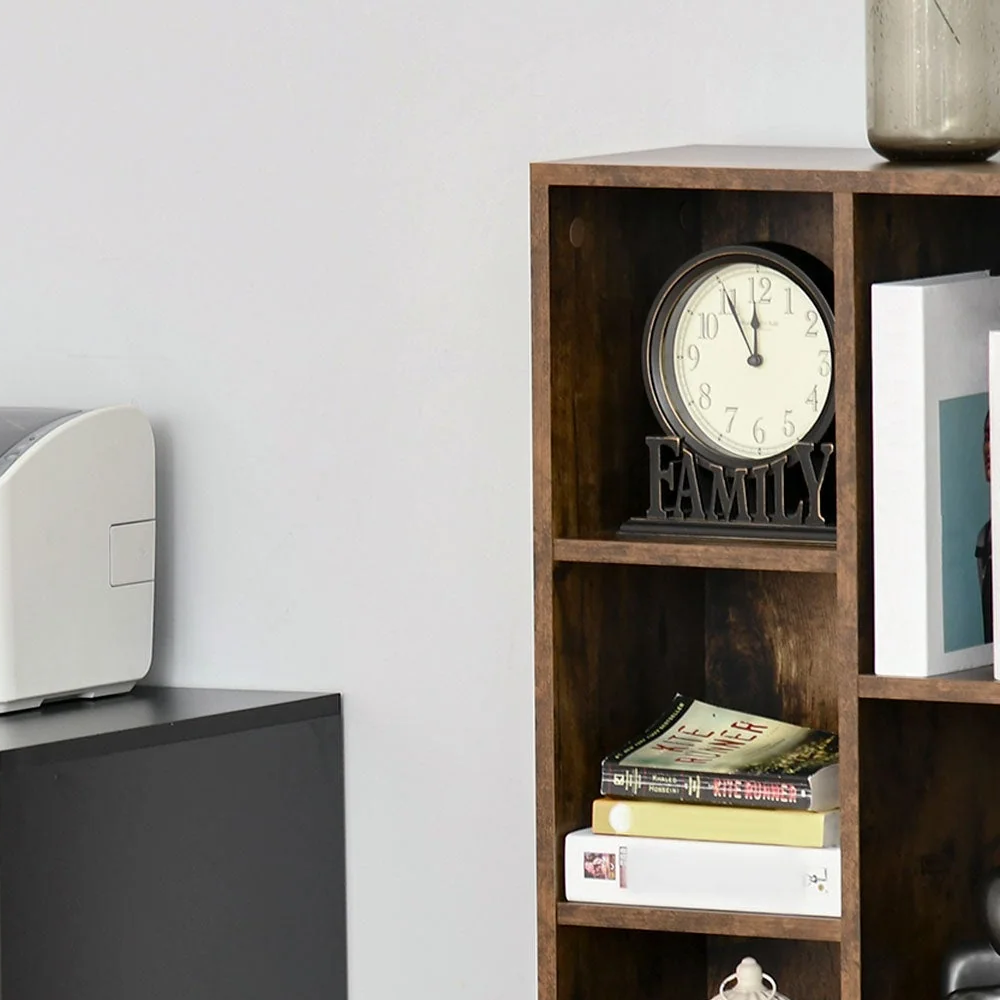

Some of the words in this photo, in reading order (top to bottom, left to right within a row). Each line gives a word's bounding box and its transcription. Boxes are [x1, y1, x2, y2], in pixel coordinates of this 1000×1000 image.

[718, 288, 740, 316] 11
[748, 276, 772, 304] 12
[784, 287, 794, 315] 1
[697, 311, 719, 340] 10
[805, 310, 819, 338] 2
[687, 344, 700, 372] 9
[818, 349, 831, 378] 3
[699, 382, 712, 410] 8
[805, 384, 819, 413] 4
[725, 406, 739, 434] 7
[753, 416, 766, 445] 6
[784, 409, 796, 438] 5
[645, 436, 834, 525] FAMILY
[651, 725, 715, 753] KITE
[675, 720, 768, 764] RUNNER
[713, 778, 742, 799] KITE
[744, 781, 797, 803] RUNNER
